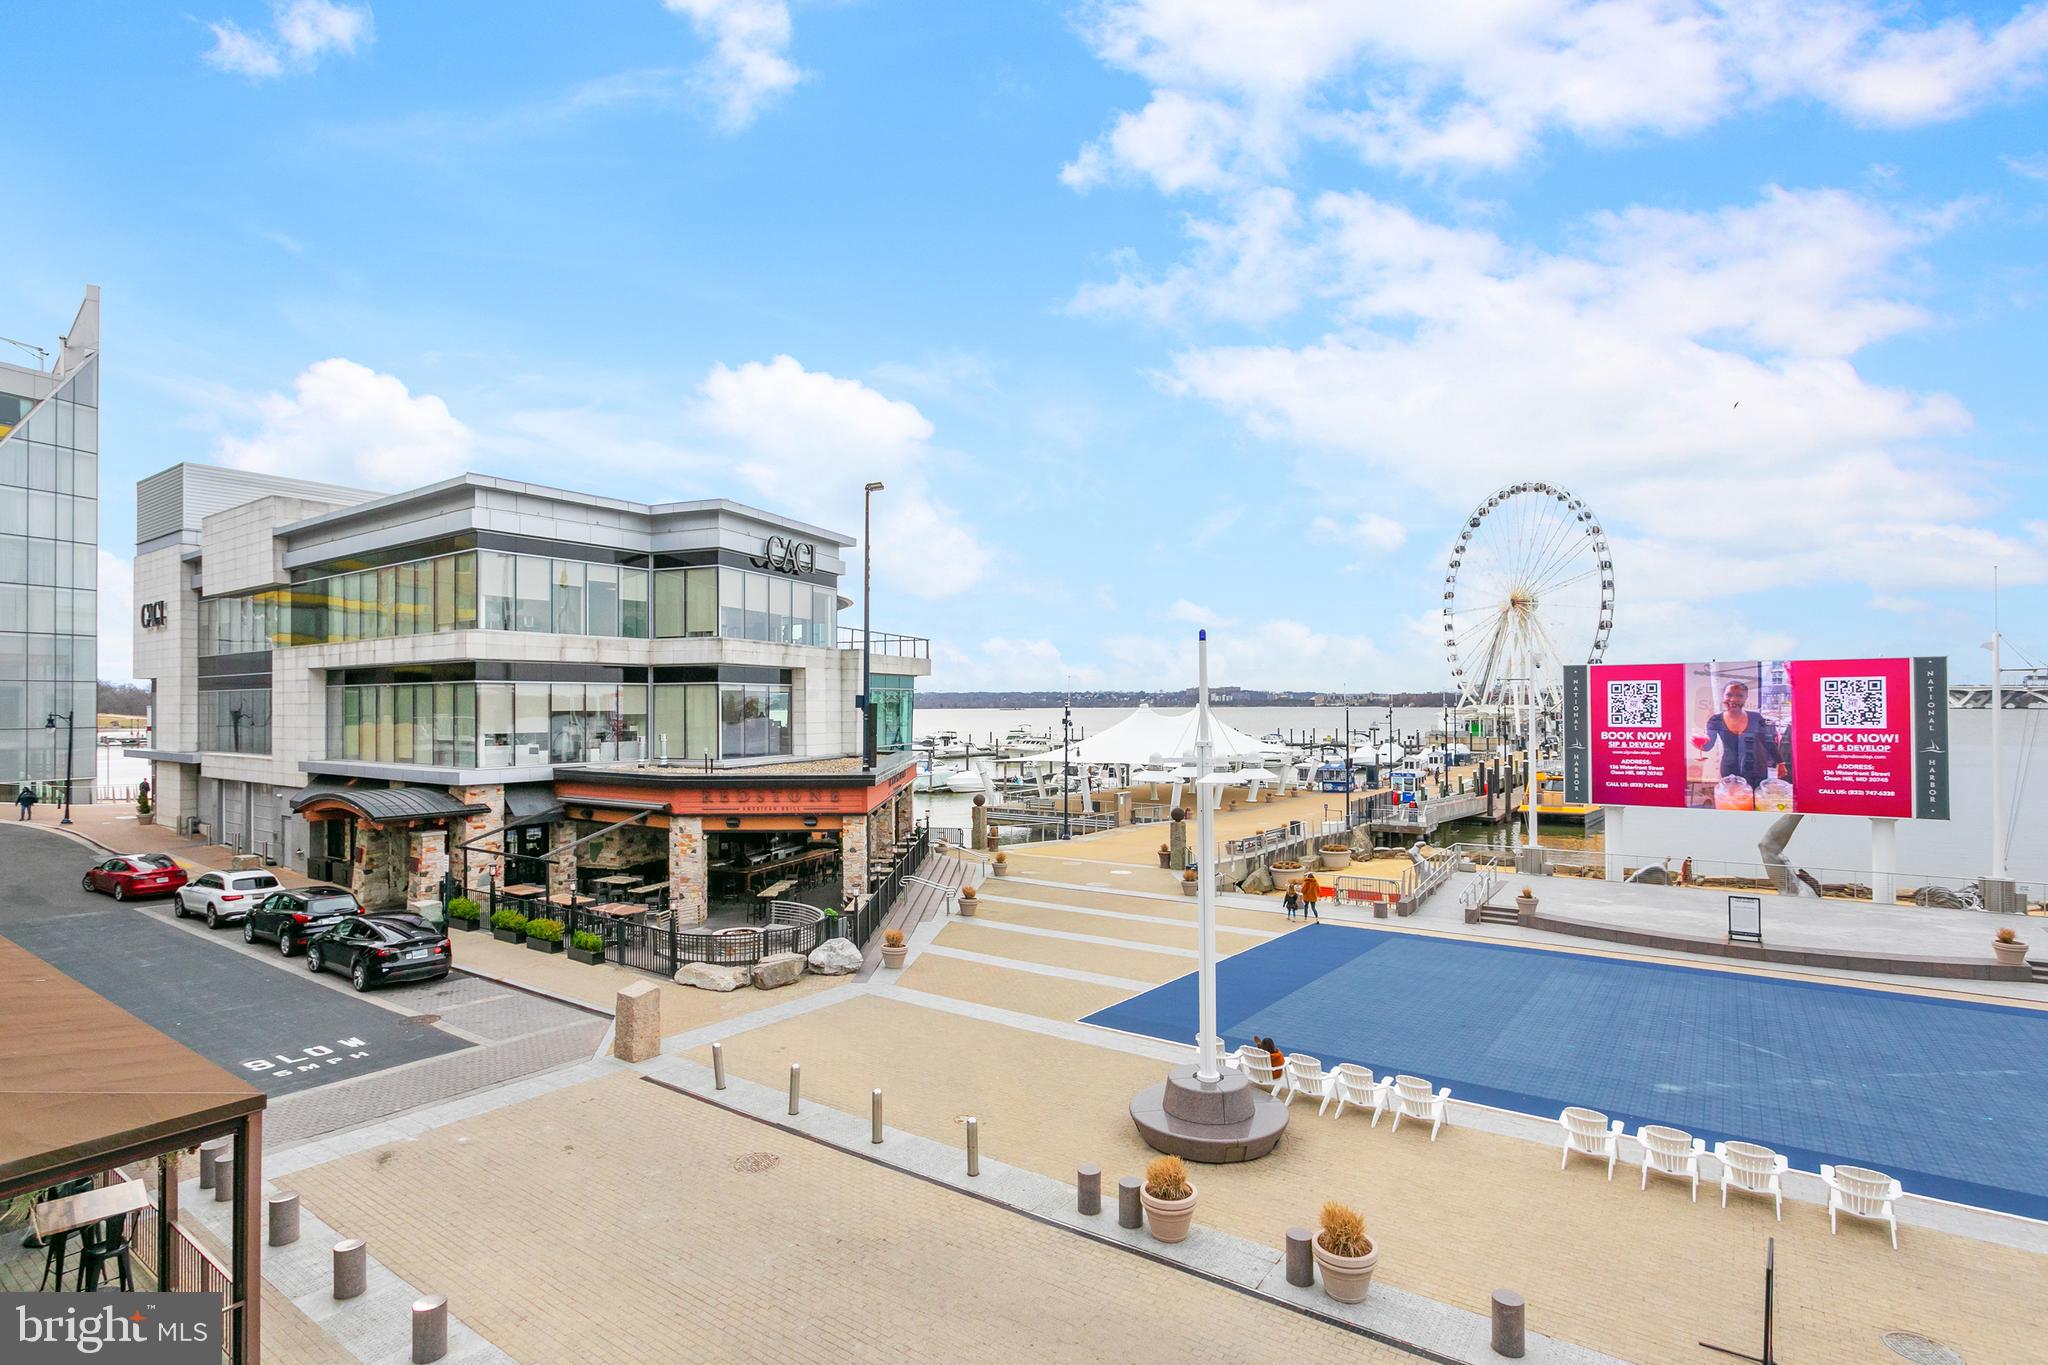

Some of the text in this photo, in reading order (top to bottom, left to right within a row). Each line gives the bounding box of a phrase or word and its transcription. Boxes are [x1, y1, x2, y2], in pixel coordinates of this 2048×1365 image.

[1927, 671, 1935, 731] NATIONAL
[1601, 731, 1672, 741] BOOK NOW!
[1812, 733, 1900, 743] BOOK NOW!
[1608, 741, 1620, 749] SIP
[1821, 744, 1836, 752] SIP
[1928, 760, 1937, 803] HARBOR
[702, 789, 839, 803] REDSTONE
[242, 1036, 366, 1072] SLOW
